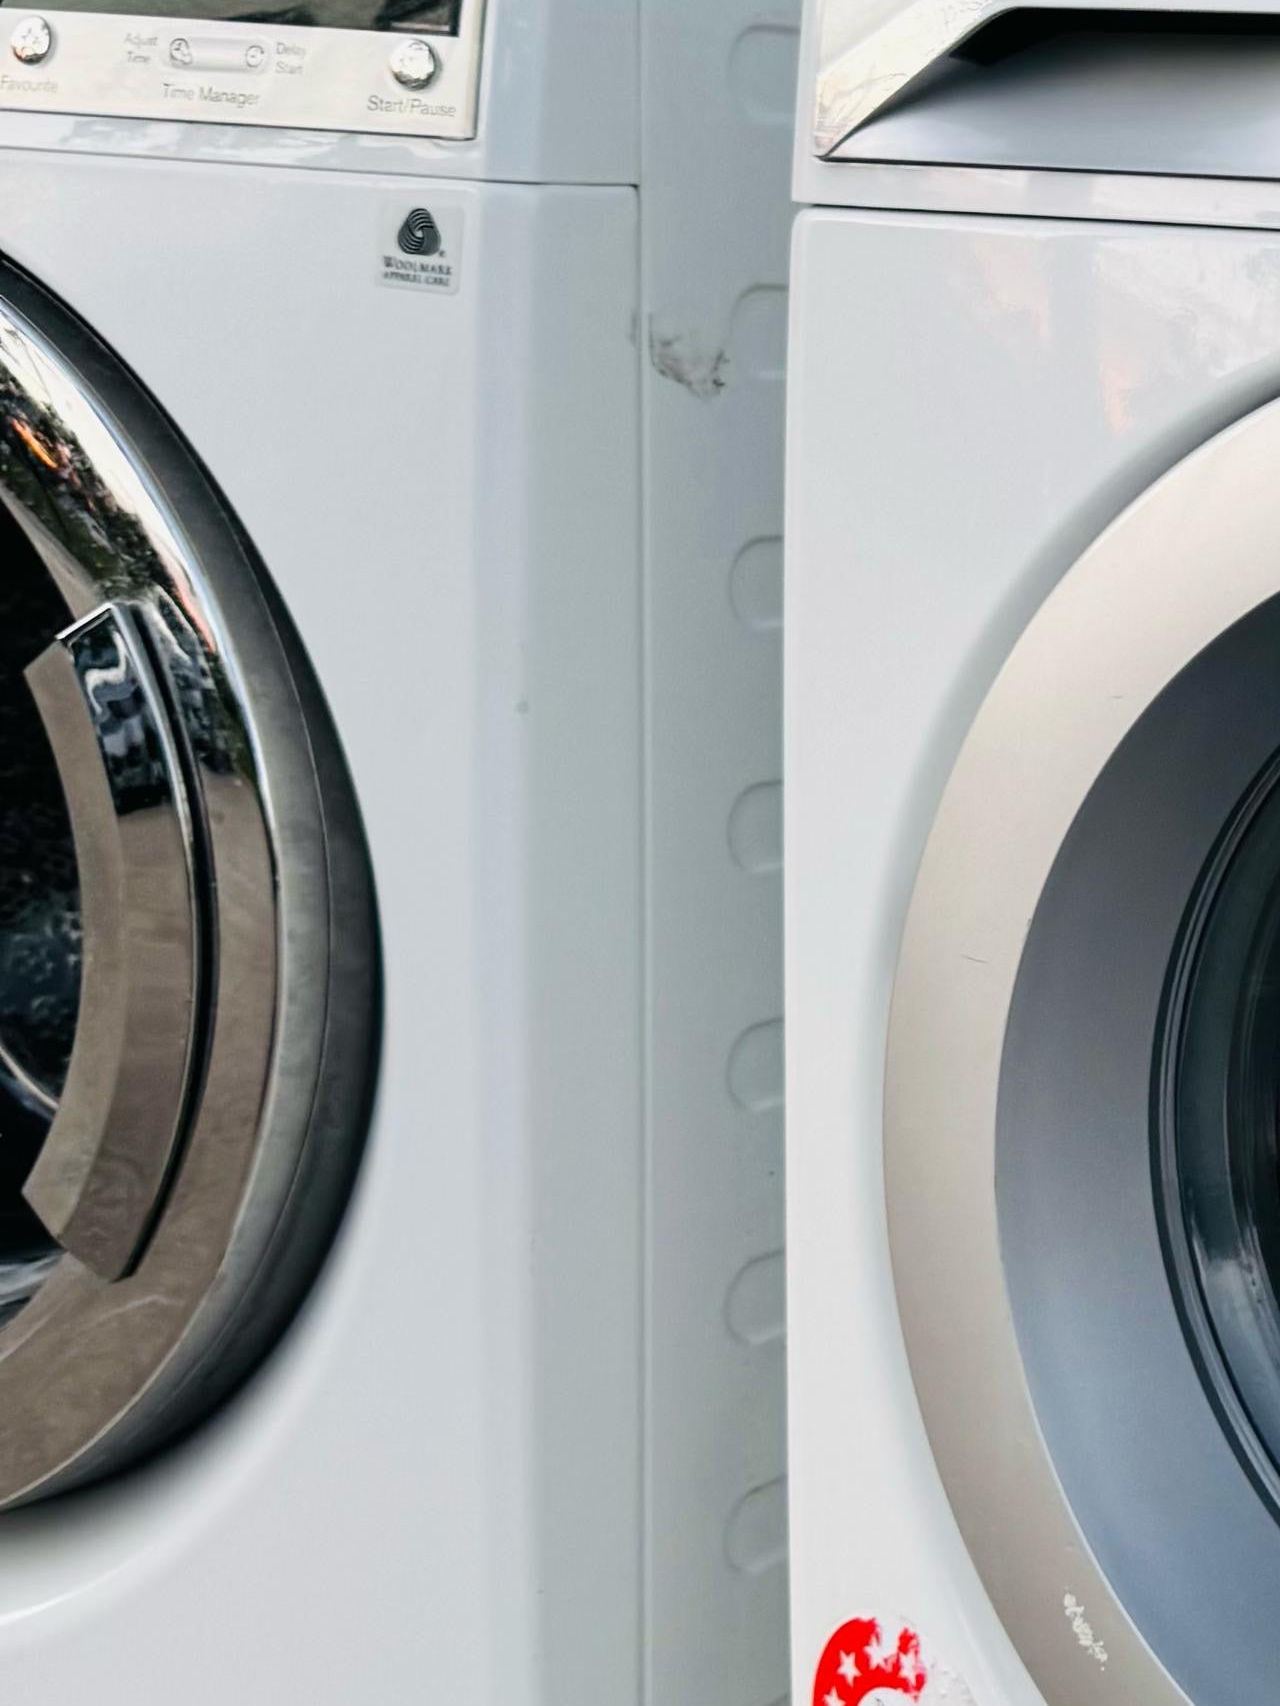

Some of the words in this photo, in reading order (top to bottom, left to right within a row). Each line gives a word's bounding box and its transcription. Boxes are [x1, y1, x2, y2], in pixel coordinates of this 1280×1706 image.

[162, 83, 194, 100] Time
[200, 86, 261, 108] Manager
[367, 95, 456, 117] Start/Pause
